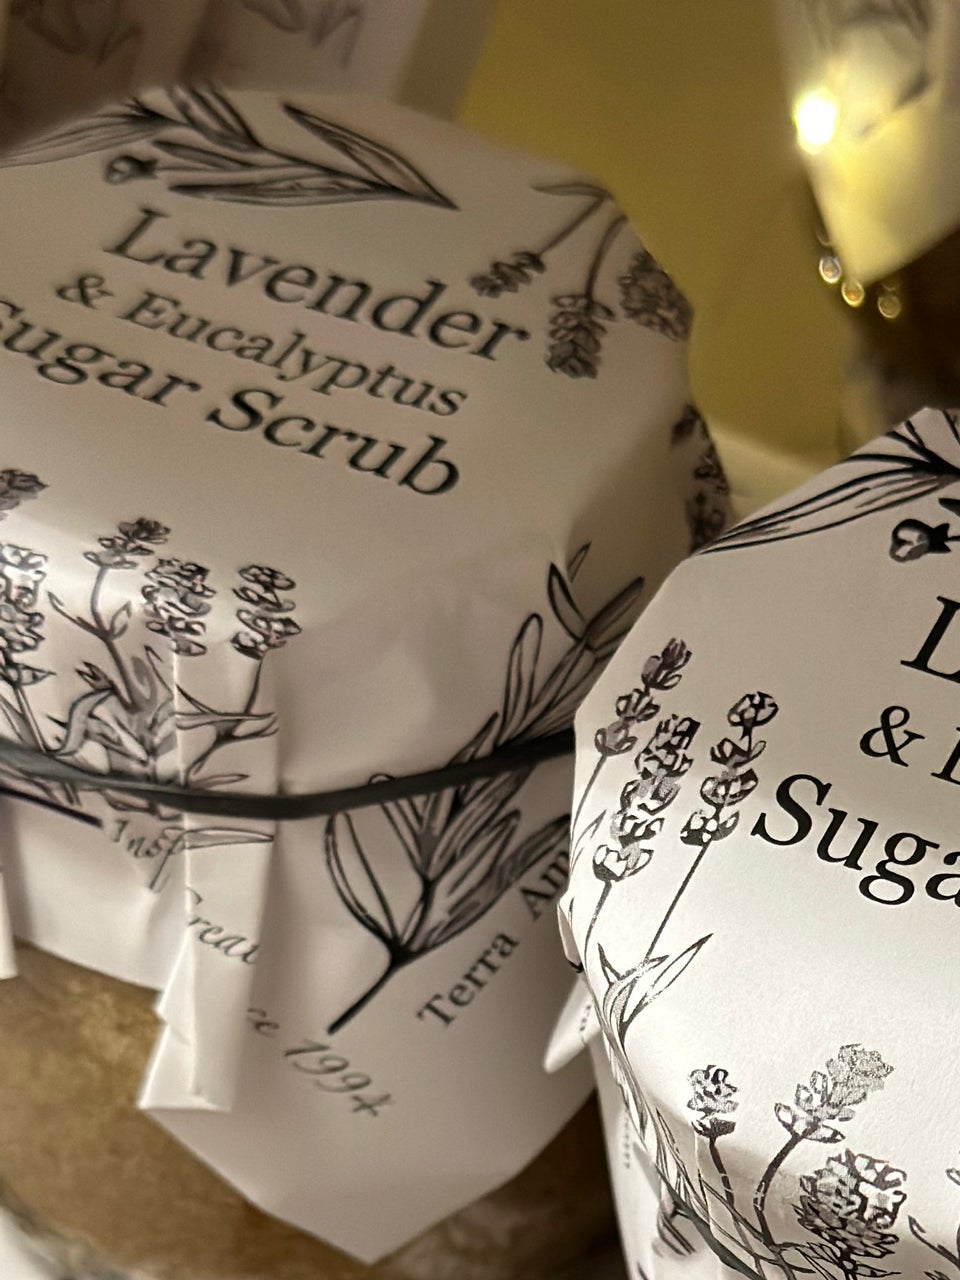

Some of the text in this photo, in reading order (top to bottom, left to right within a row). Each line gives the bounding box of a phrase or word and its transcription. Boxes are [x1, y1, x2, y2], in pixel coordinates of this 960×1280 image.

[103, 206, 530, 362] Lavender
[56, 273, 468, 418] & Eucalyptus
[206, 387, 462, 497] Scrub
[860, 705, 925, 768] &
[416, 932, 520, 1027] Terra
[284, 1038, 393, 1117] 1994
